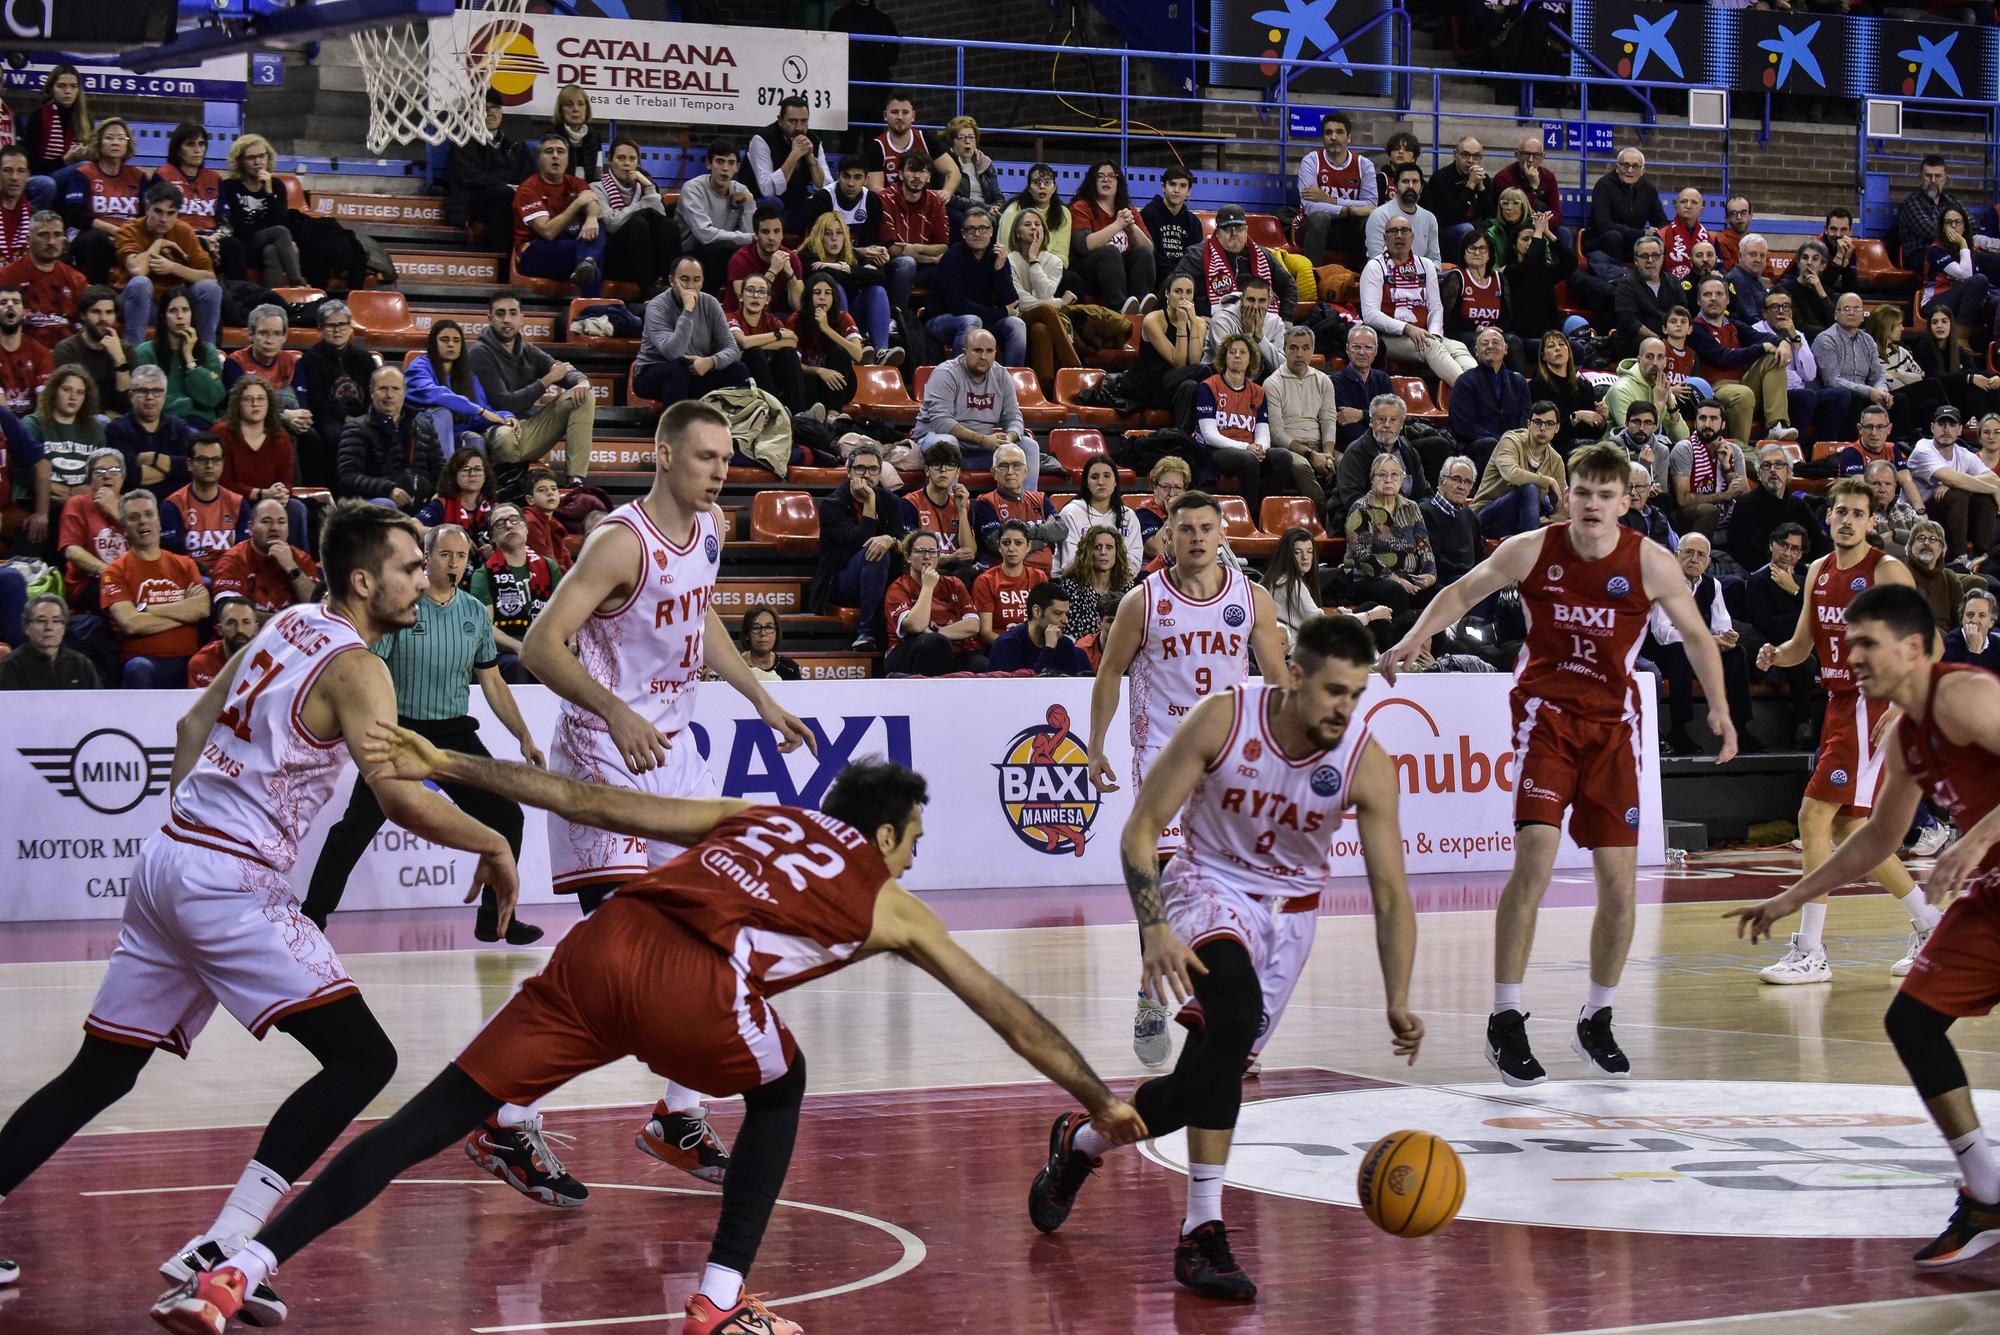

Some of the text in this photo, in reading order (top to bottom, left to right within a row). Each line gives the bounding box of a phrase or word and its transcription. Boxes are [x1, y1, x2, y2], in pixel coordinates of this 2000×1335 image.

[556, 37, 738, 67] CATALANA
[262, 66, 273, 82] 3
[557, 64, 739, 94] DE TREBALL
[616, 94, 630, 105] de
[634, 95, 677, 108] Treball
[1548, 133, 1557, 147] 4
[336, 204, 400, 217] NETEGES
[447, 264, 494, 277] BAGES
[745, 592, 795, 606] BAGES
[1553, 603, 1616, 628] BAXI
[1161, 630, 1242, 660] RYTAS
[1571, 634, 1598, 664] 12
[1829, 636, 1839, 663] 5
[815, 665, 866, 680] BAGES
[1195, 667, 1212, 696] 9
[82, 761, 140, 783] MINI
[1002, 766, 1097, 802] BAXI
[1023, 809, 1084, 827] MANRESA
[1220, 787, 1324, 833] RYTAS
[17, 838, 107, 860] MOTOR
[735, 815, 846, 893] 22
[1416, 832, 1433, 854] &
[399, 859, 457, 888] CADÍ
